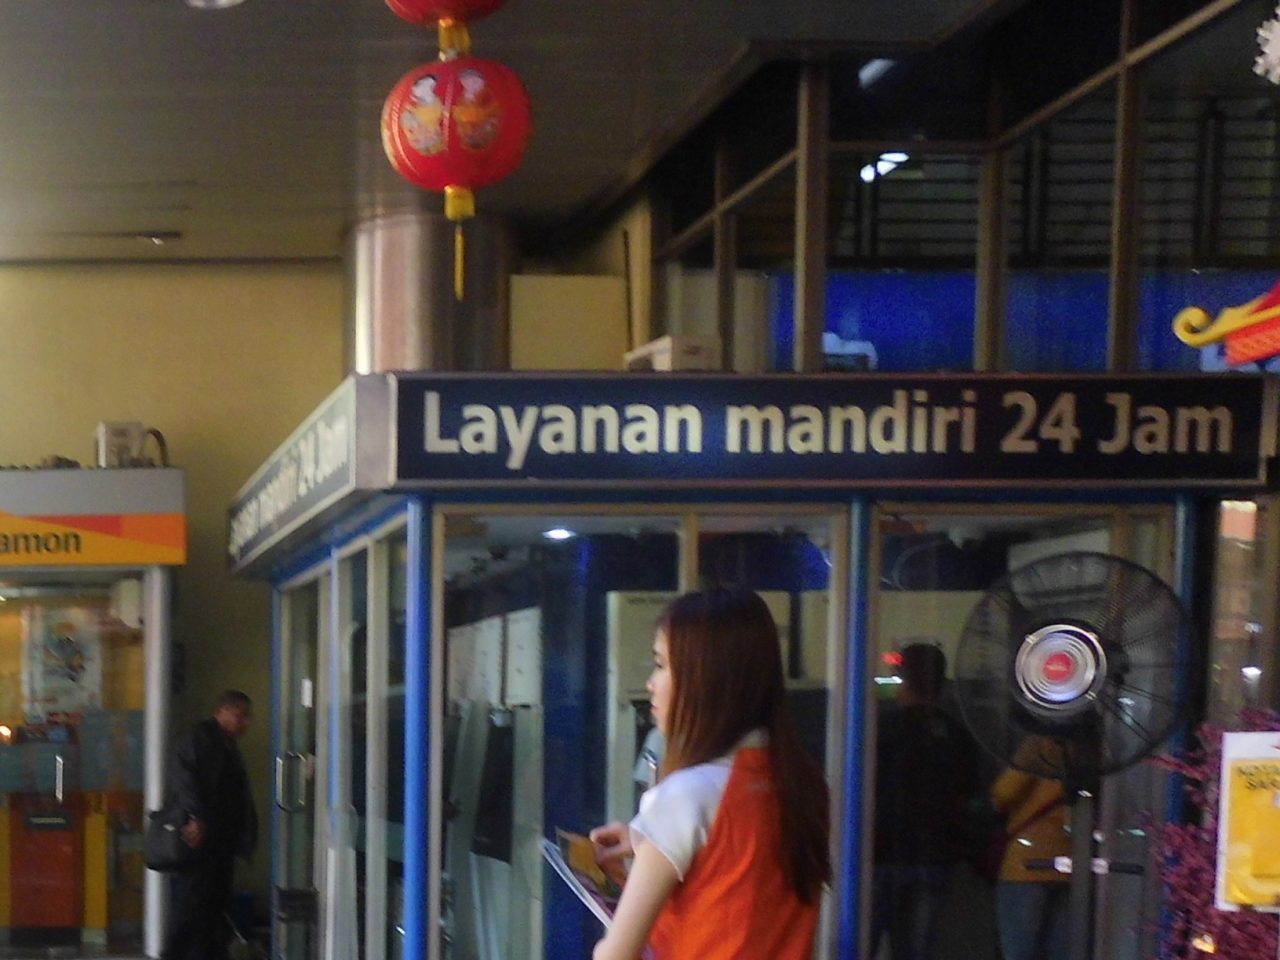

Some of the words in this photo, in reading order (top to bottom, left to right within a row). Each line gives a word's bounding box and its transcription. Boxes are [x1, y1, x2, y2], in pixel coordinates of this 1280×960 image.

[424, 390, 704, 470] Layanan
[725, 389, 978, 455] mandiri
[998, 390, 1083, 455] 24
[1096, 391, 1234, 455] Jam
